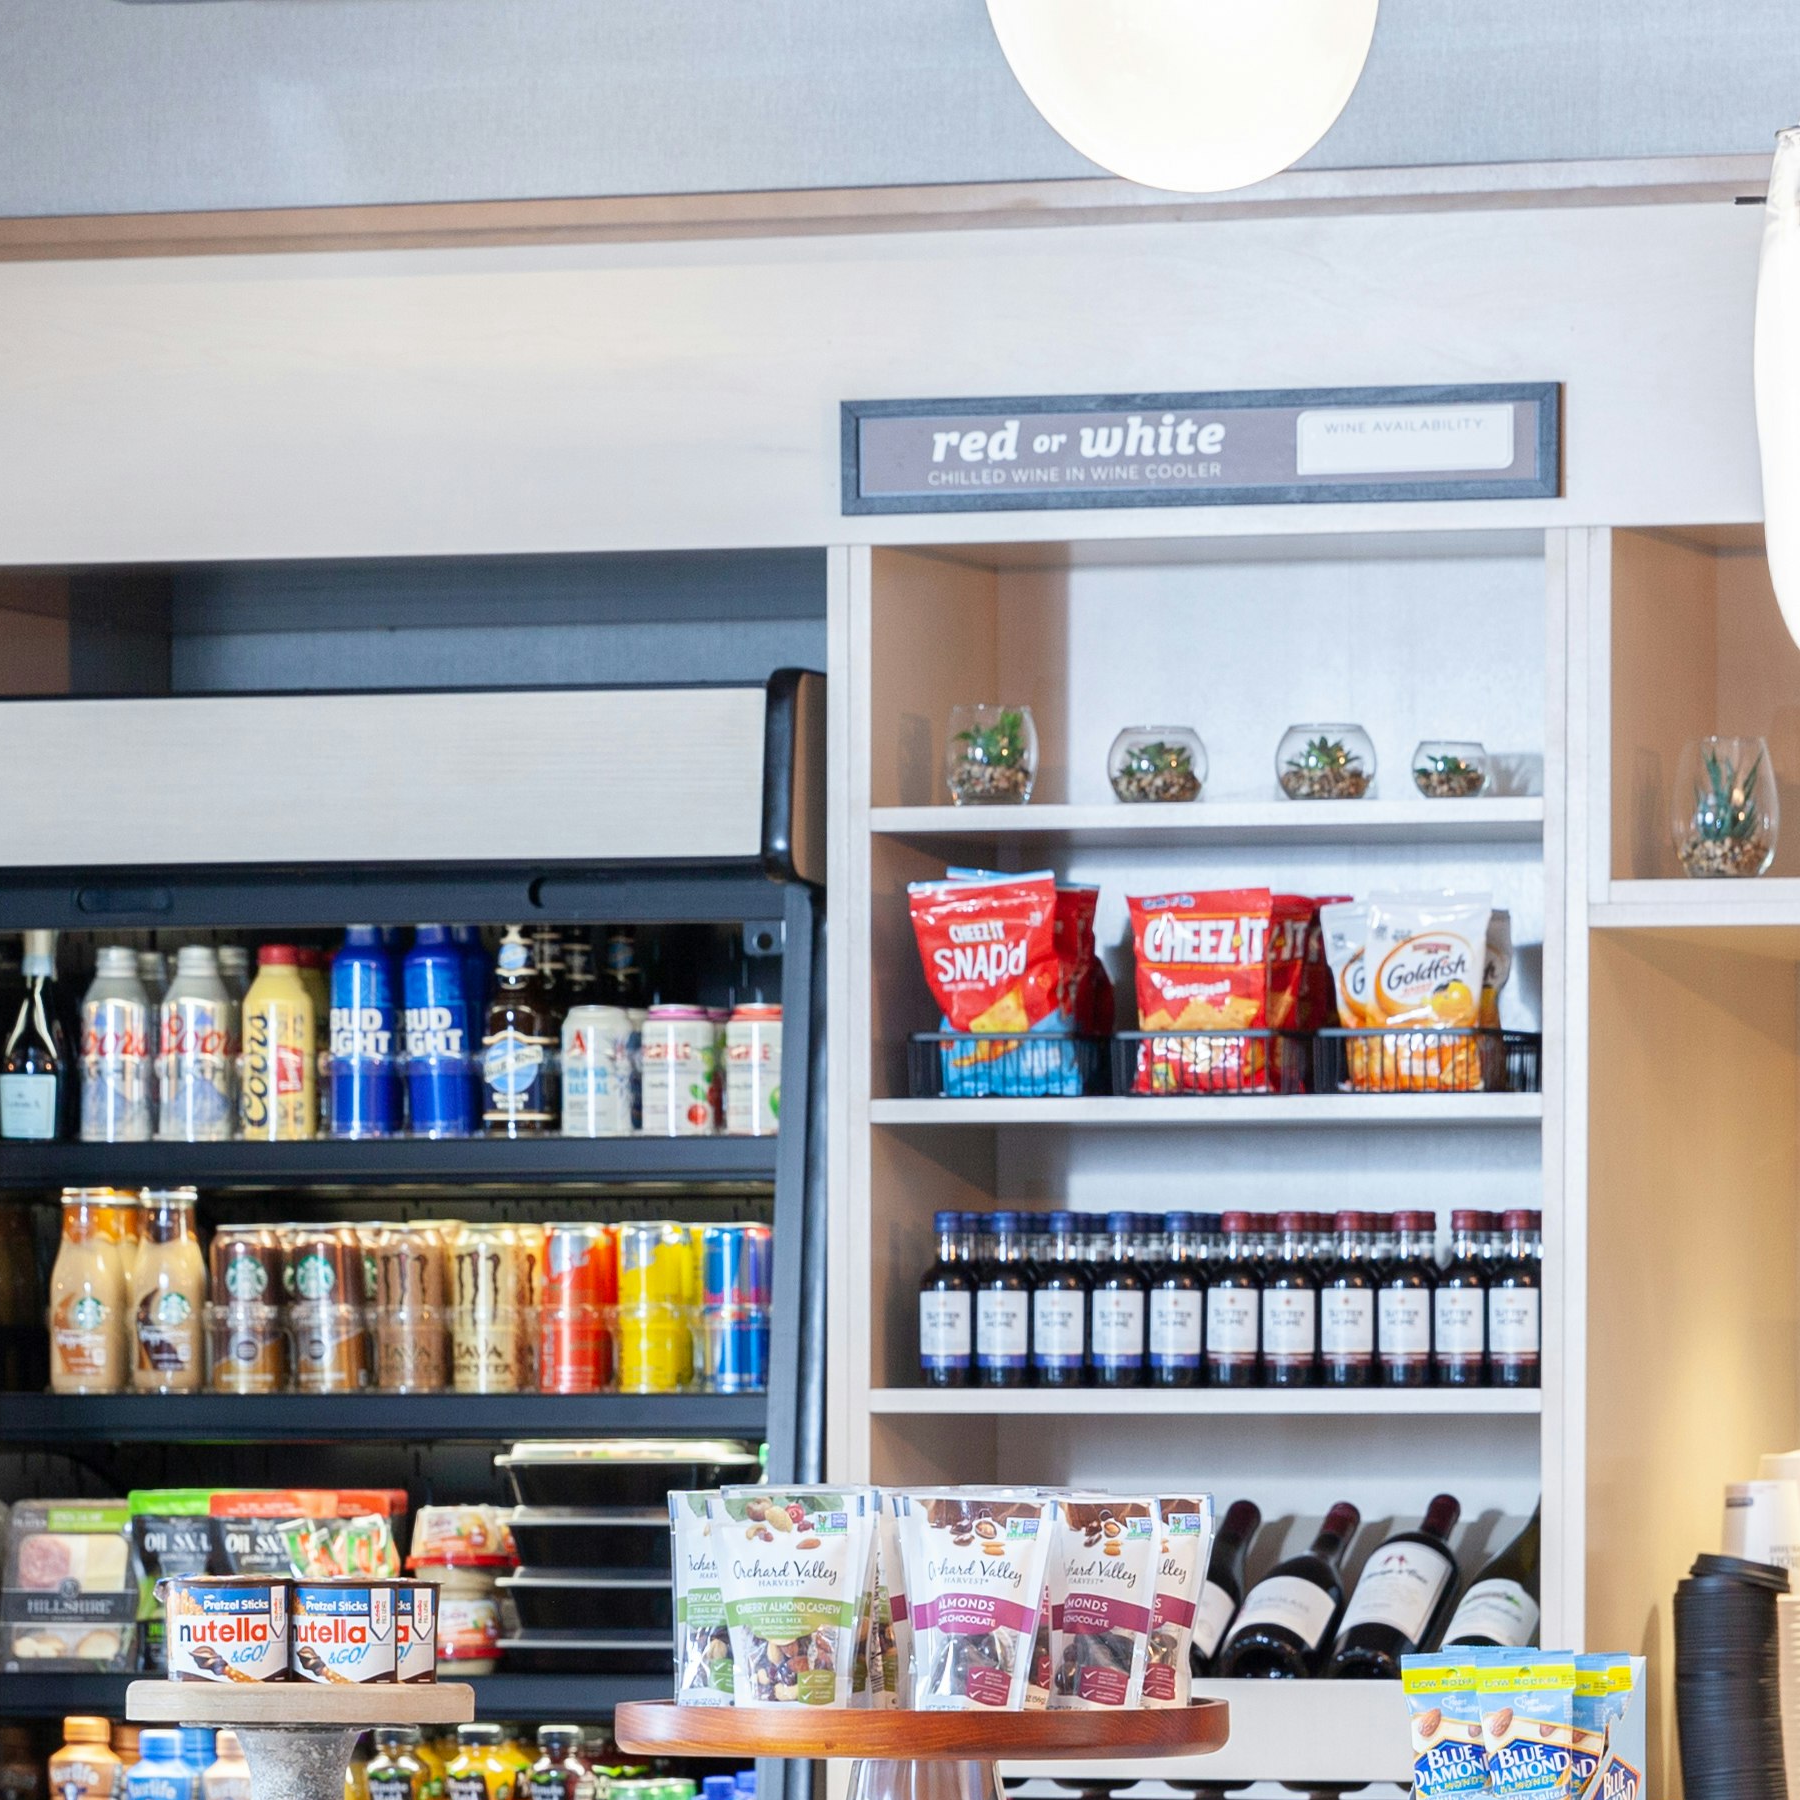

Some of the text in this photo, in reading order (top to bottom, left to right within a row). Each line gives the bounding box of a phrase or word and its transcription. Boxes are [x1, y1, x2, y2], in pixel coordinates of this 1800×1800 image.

[931, 413, 1227, 464] red or white
[1324, 420, 1368, 437] WINE
[928, 462, 1223, 487] CHILLED WINE IN WINE COOLER
[1386, 951, 1469, 993] Goldfish
[243, 1012, 269, 1128] Coors
[733, 1559, 838, 1587] Orchard Valley
[980, 1559, 1023, 1588] Valley
[1098, 1559, 1137, 1588] Valley
[203, 1598, 269, 1611] Pretzel Sticks
[306, 1600, 369, 1611] Pretzel Sticks
[769, 1601, 806, 1614] ALMOND
[807, 1602, 842, 1615] CASHEW
[938, 1597, 996, 1613] ALMONDS
[180, 1617, 268, 1643] nutella
[292, 1618, 367, 1643] nutella
[759, 1617, 802, 1625] TRAIL MIX
[947, 1614, 996, 1627] CHOCOLATE
[230, 1640, 271, 1664] &GO!
[328, 1642, 371, 1665] &GO!
[1427, 1743, 1474, 1769] BLUE
[1497, 1743, 1547, 1770] BLUE
[1602, 1766, 1627, 1799] BLUE
